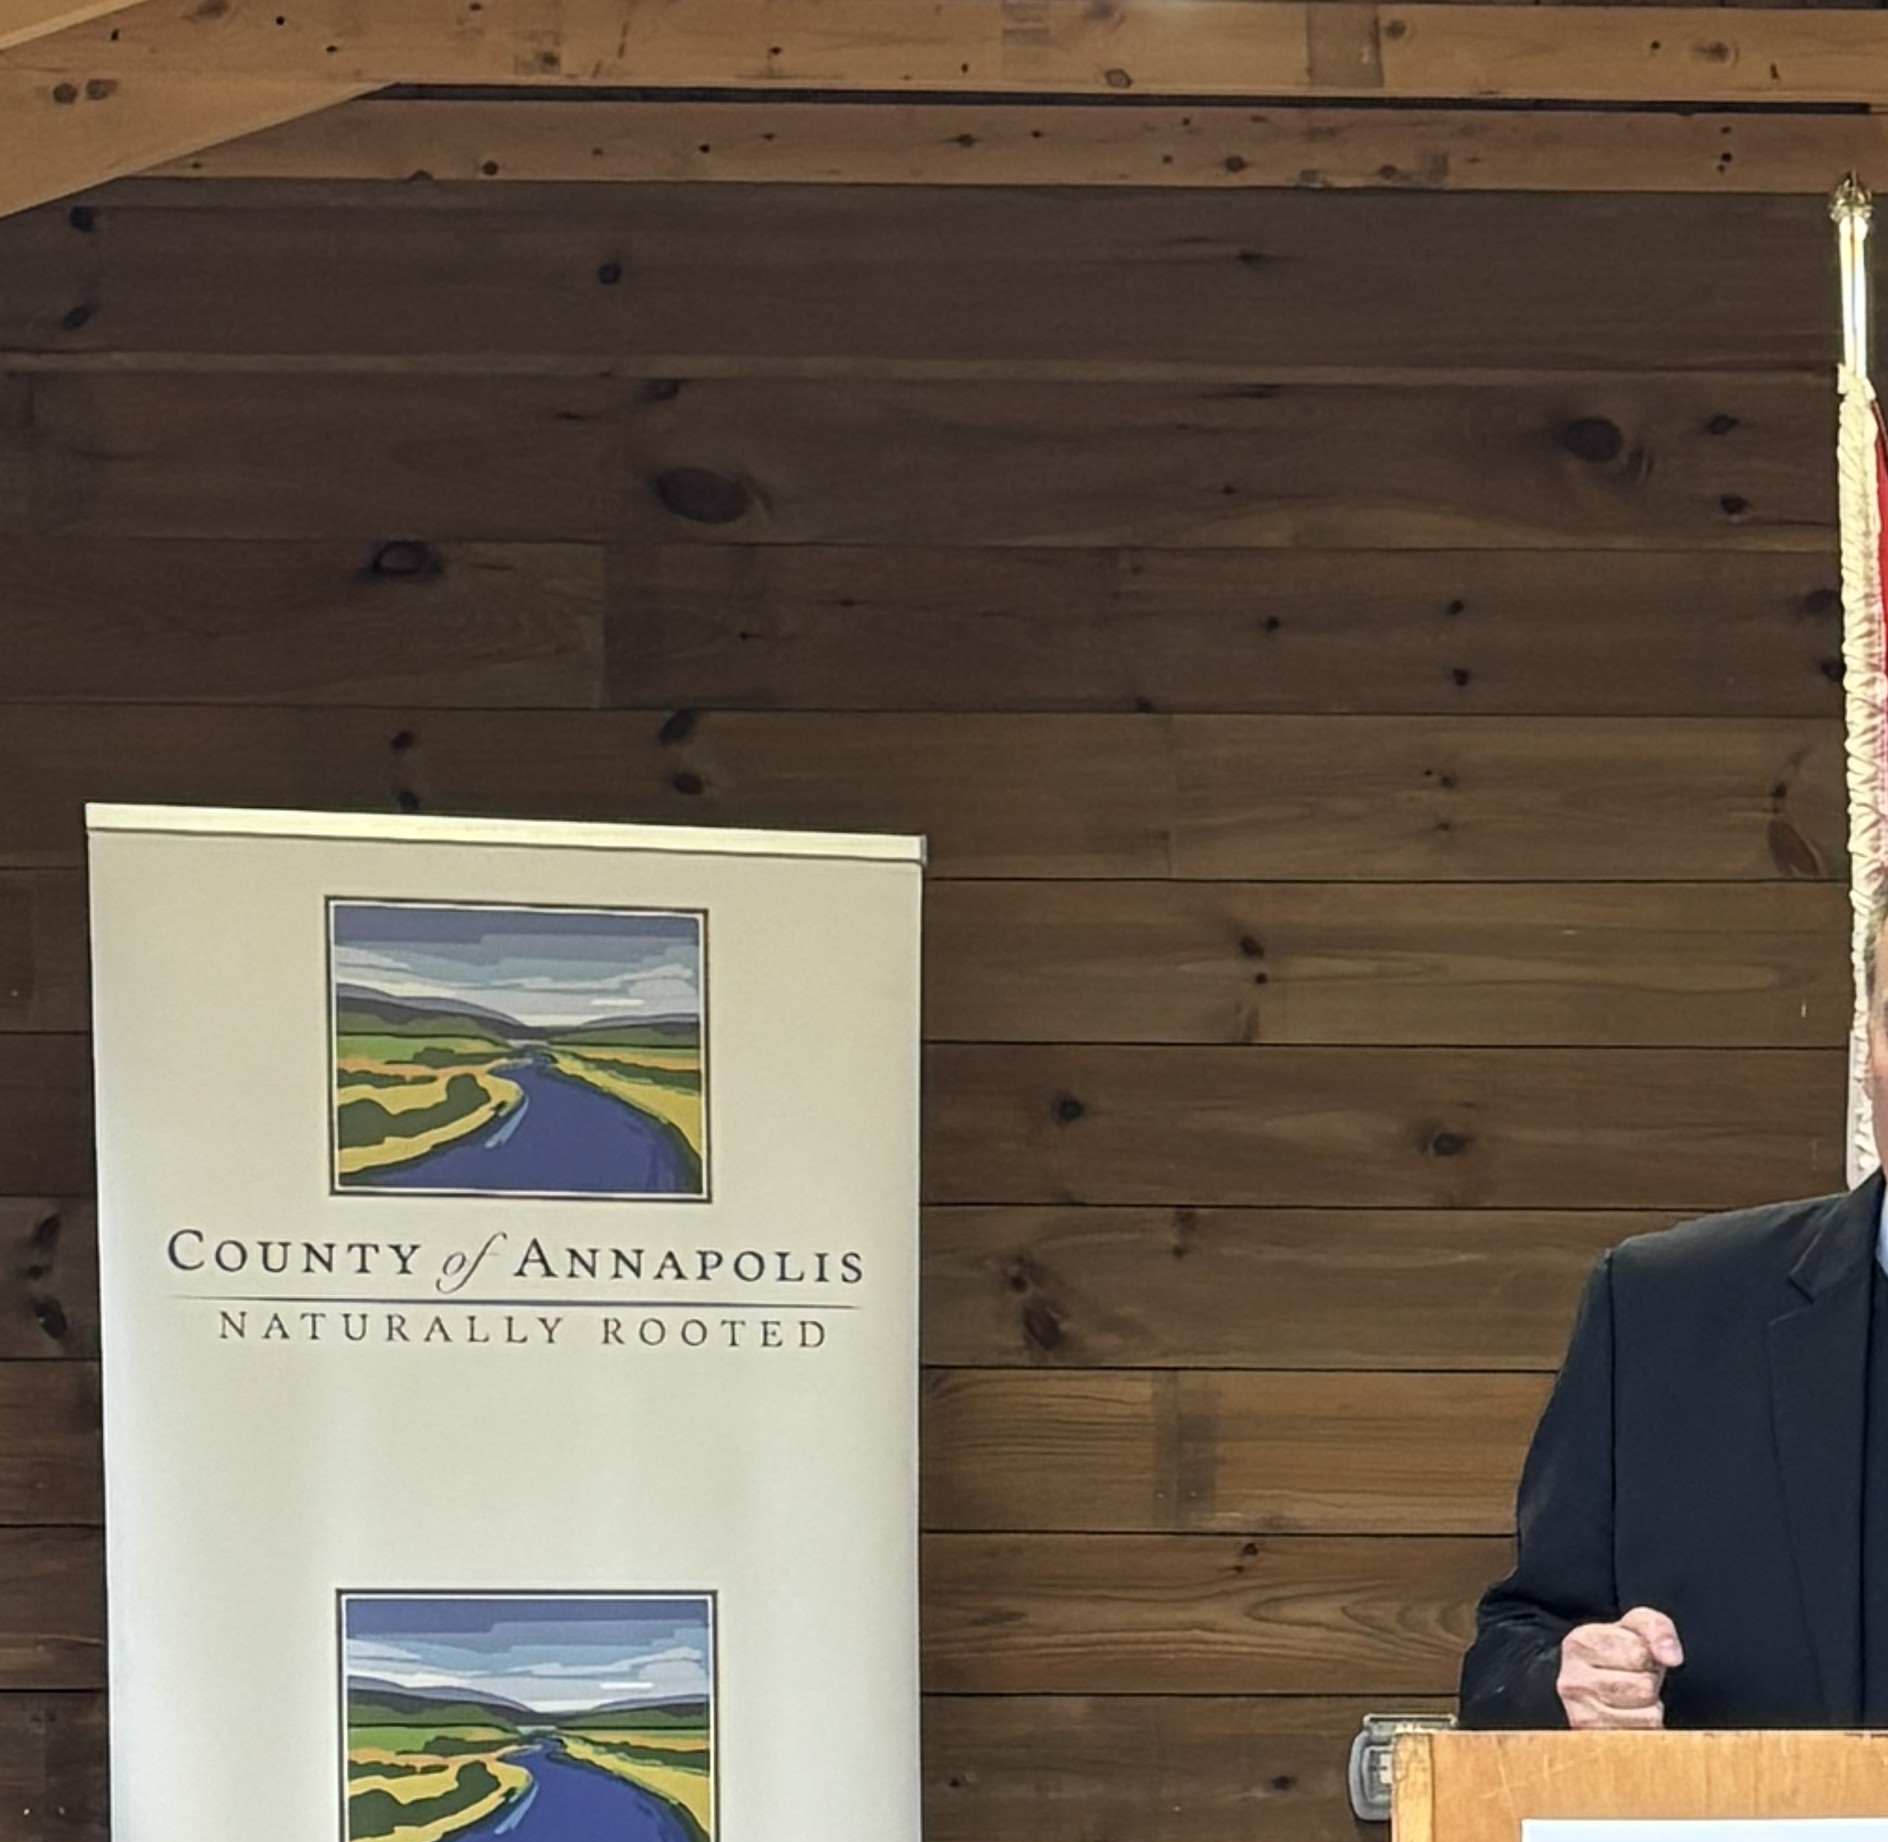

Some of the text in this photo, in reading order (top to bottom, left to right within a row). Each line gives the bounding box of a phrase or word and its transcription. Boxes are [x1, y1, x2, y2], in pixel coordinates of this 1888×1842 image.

[435, 1231, 508, 1293] of
[219, 1310, 825, 1348] NATURALLY ROOTED
